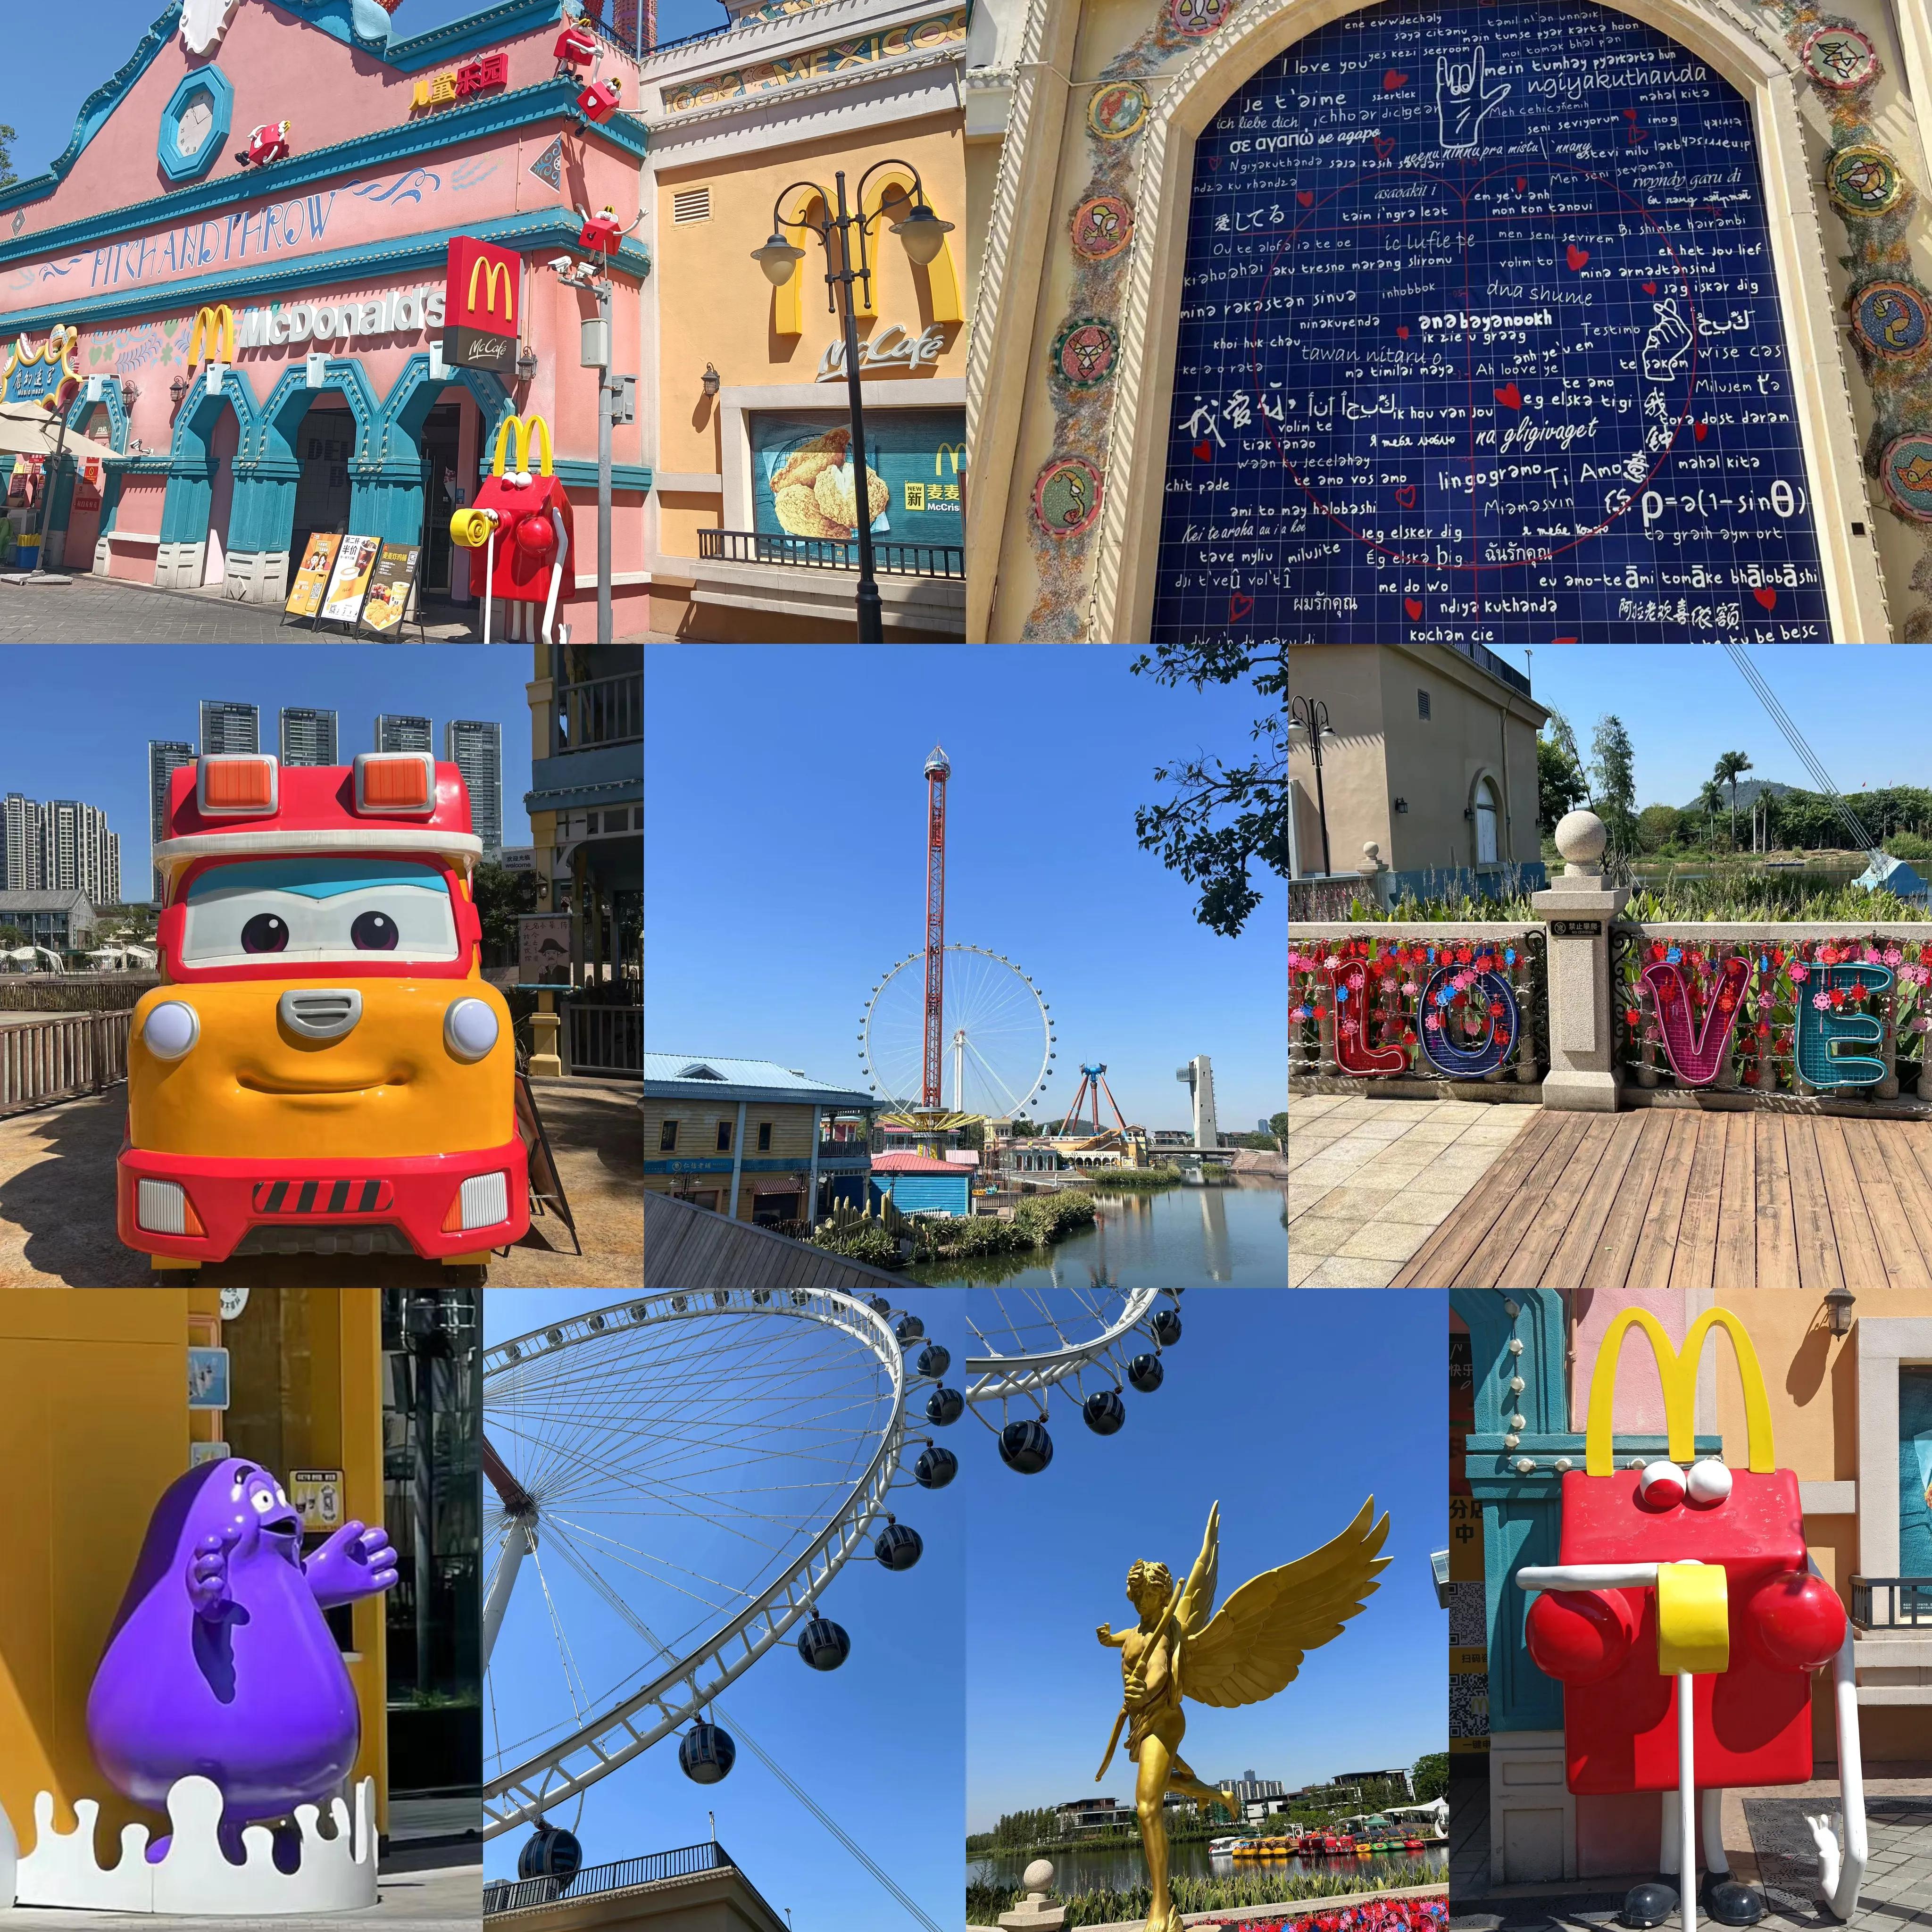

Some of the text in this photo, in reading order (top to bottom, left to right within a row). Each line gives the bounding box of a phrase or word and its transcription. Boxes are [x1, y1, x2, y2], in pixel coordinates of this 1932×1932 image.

[773, 21, 948, 85] MEXICO
[1369, 51, 1386, 61] yes
[1296, 59, 1330, 74] love
[1340, 61, 1367, 74] you
[408, 53, 508, 111] 儿童乐园
[1217, 116, 1299, 129] ich liebe dich
[1492, 206, 1516, 215] mon
[1737, 278, 1758, 294] dig
[237, 285, 446, 348] McDonald's
[468, 339, 507, 360] McCafé
[1524, 394, 1543, 409] eg
[1701, 411, 1734, 425] dost
[1279, 421, 1332, 433] volim te
[1475, 430, 1496, 446] na
[1351, 474, 1374, 485] vos
[908, 492, 922, 506] 新
[927, 484, 959, 501] 麦麦
[927, 503, 961, 513] McCris
[1259, 506, 1274, 516] to
[1391, 525, 1433, 539] elsker
[1441, 524, 1462, 542] dig
[345, 537, 360, 545] 第二杯
[342, 545, 358, 555] 半价
[1379, 579, 1448, 592] me do wo
[1471, 627, 1494, 641] cie
[1755, 628, 1775, 643] be
